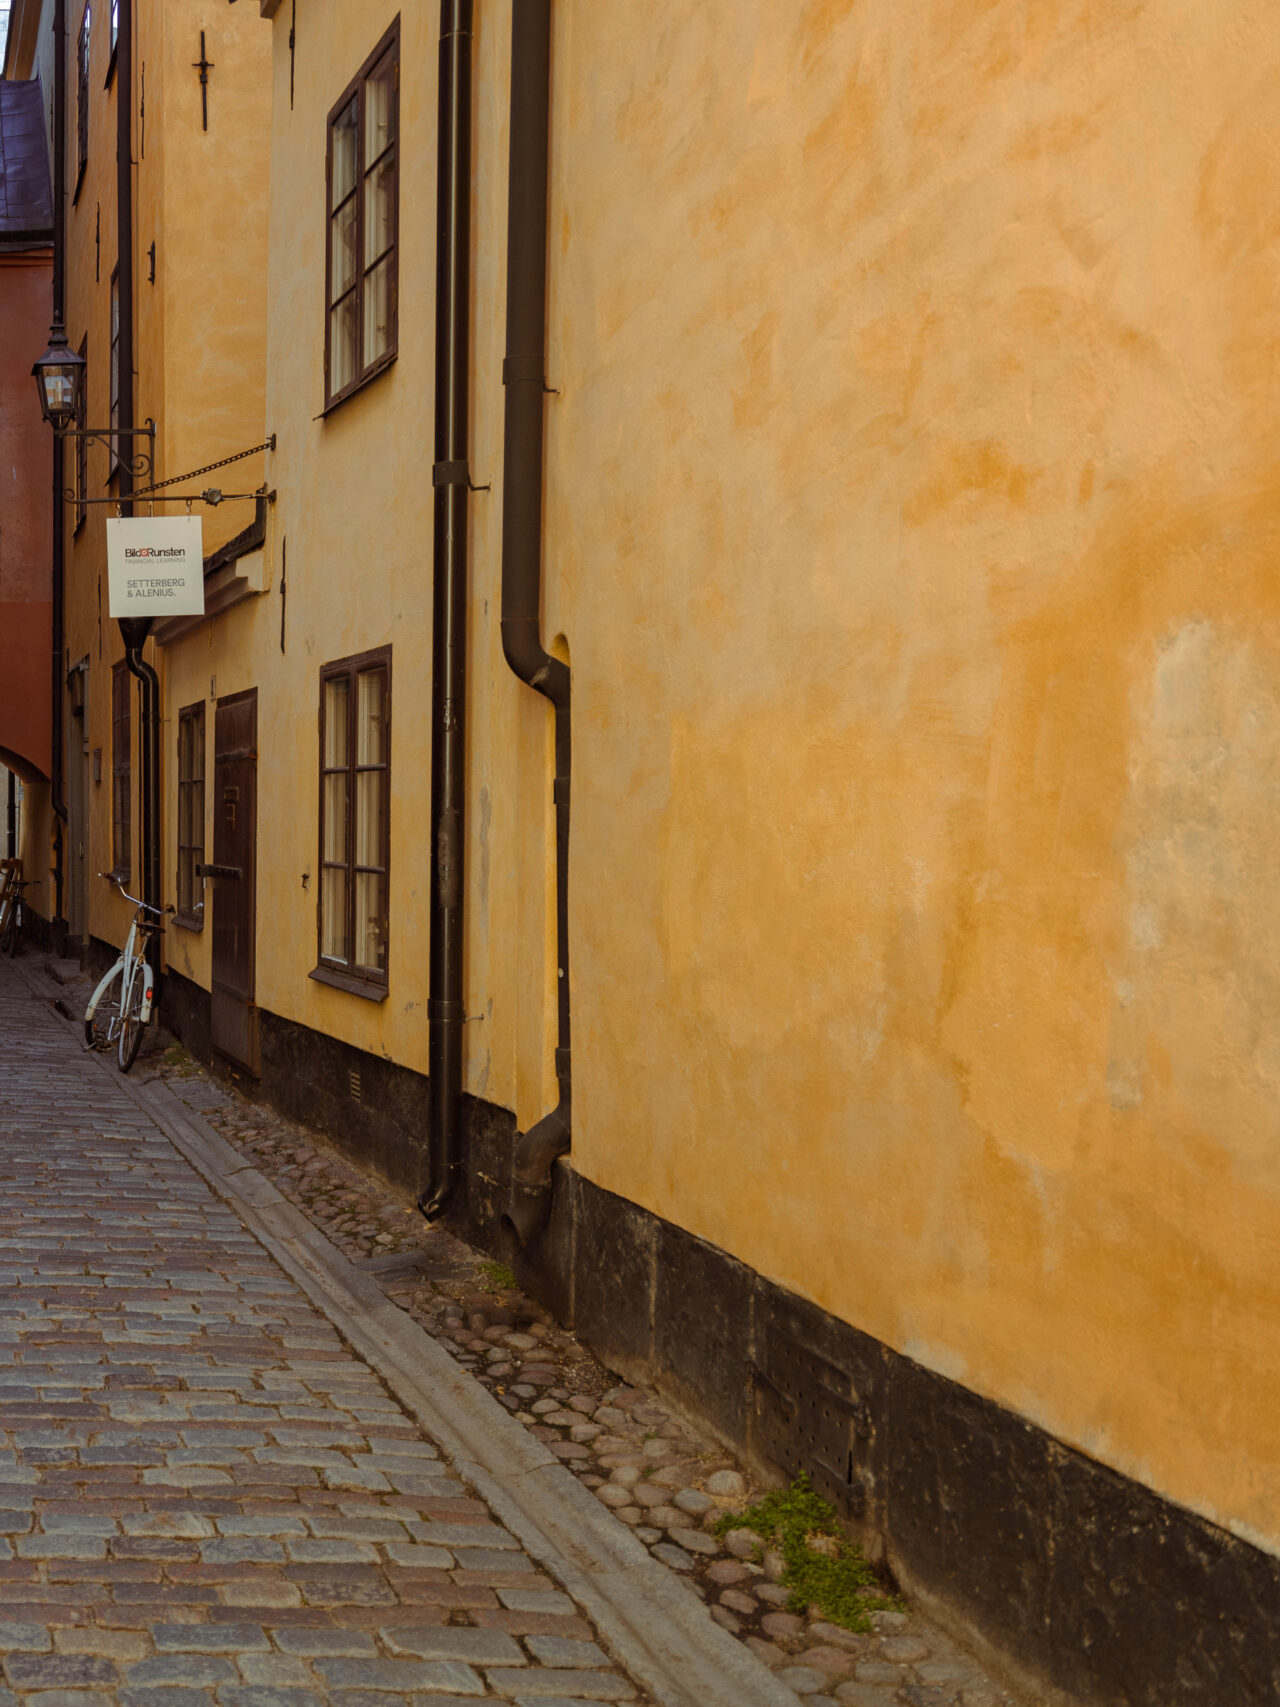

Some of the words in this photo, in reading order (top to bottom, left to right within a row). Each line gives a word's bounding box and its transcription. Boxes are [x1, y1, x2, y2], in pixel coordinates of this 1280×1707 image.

[127, 578, 185, 588] SETTERBERG
[127, 589, 133, 598] &
[135, 588, 176, 598] ALENIUS.
